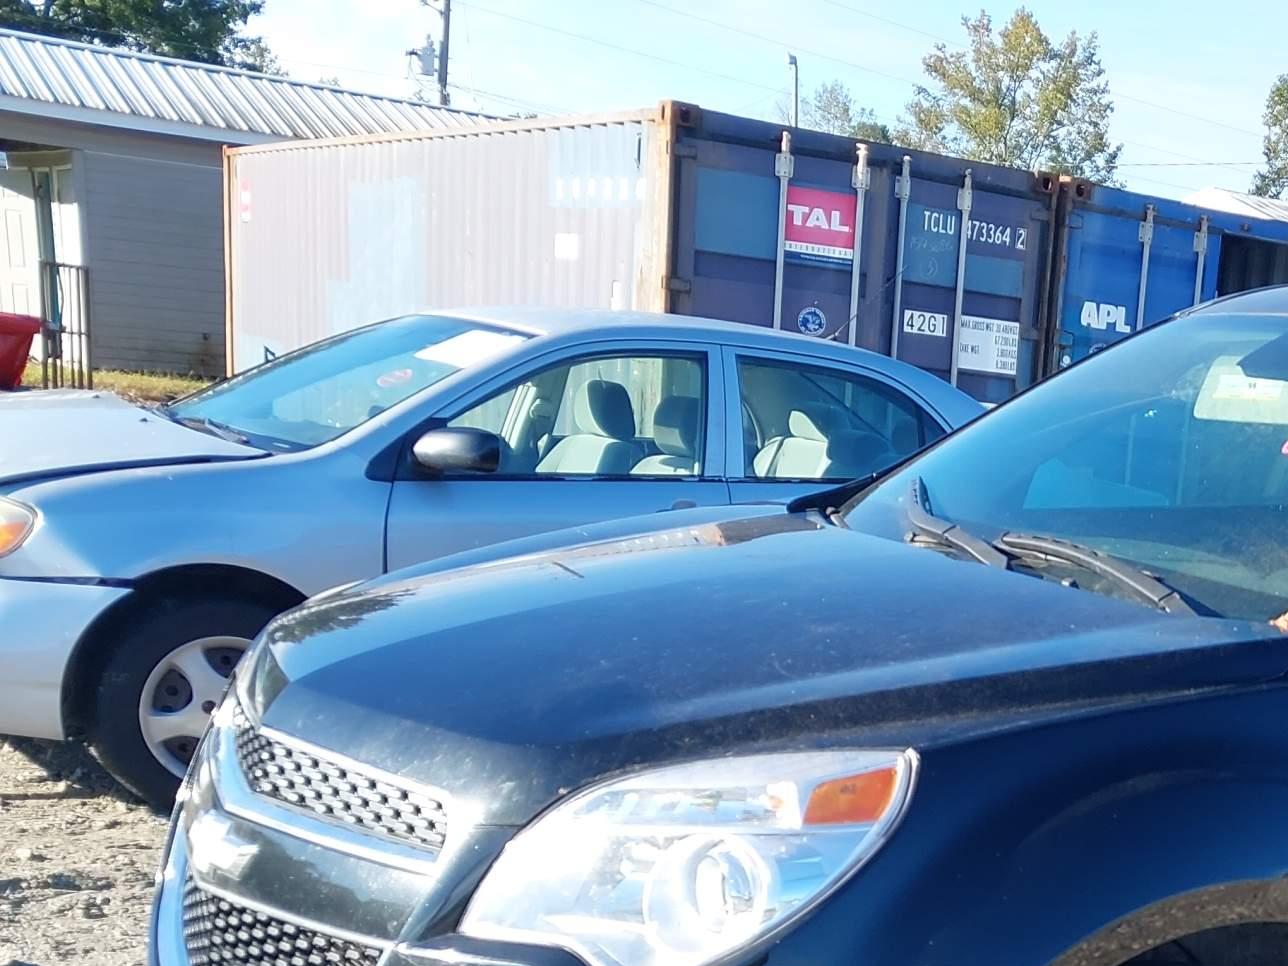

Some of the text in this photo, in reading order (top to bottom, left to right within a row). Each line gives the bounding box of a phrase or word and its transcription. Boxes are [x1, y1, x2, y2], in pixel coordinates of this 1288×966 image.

[787, 204, 850, 233] TAL
[924, 210, 956, 235] TCLU
[1016, 229, 1026, 249] 2
[906, 312, 946, 335] 42G1
[1080, 301, 1131, 333] APL
